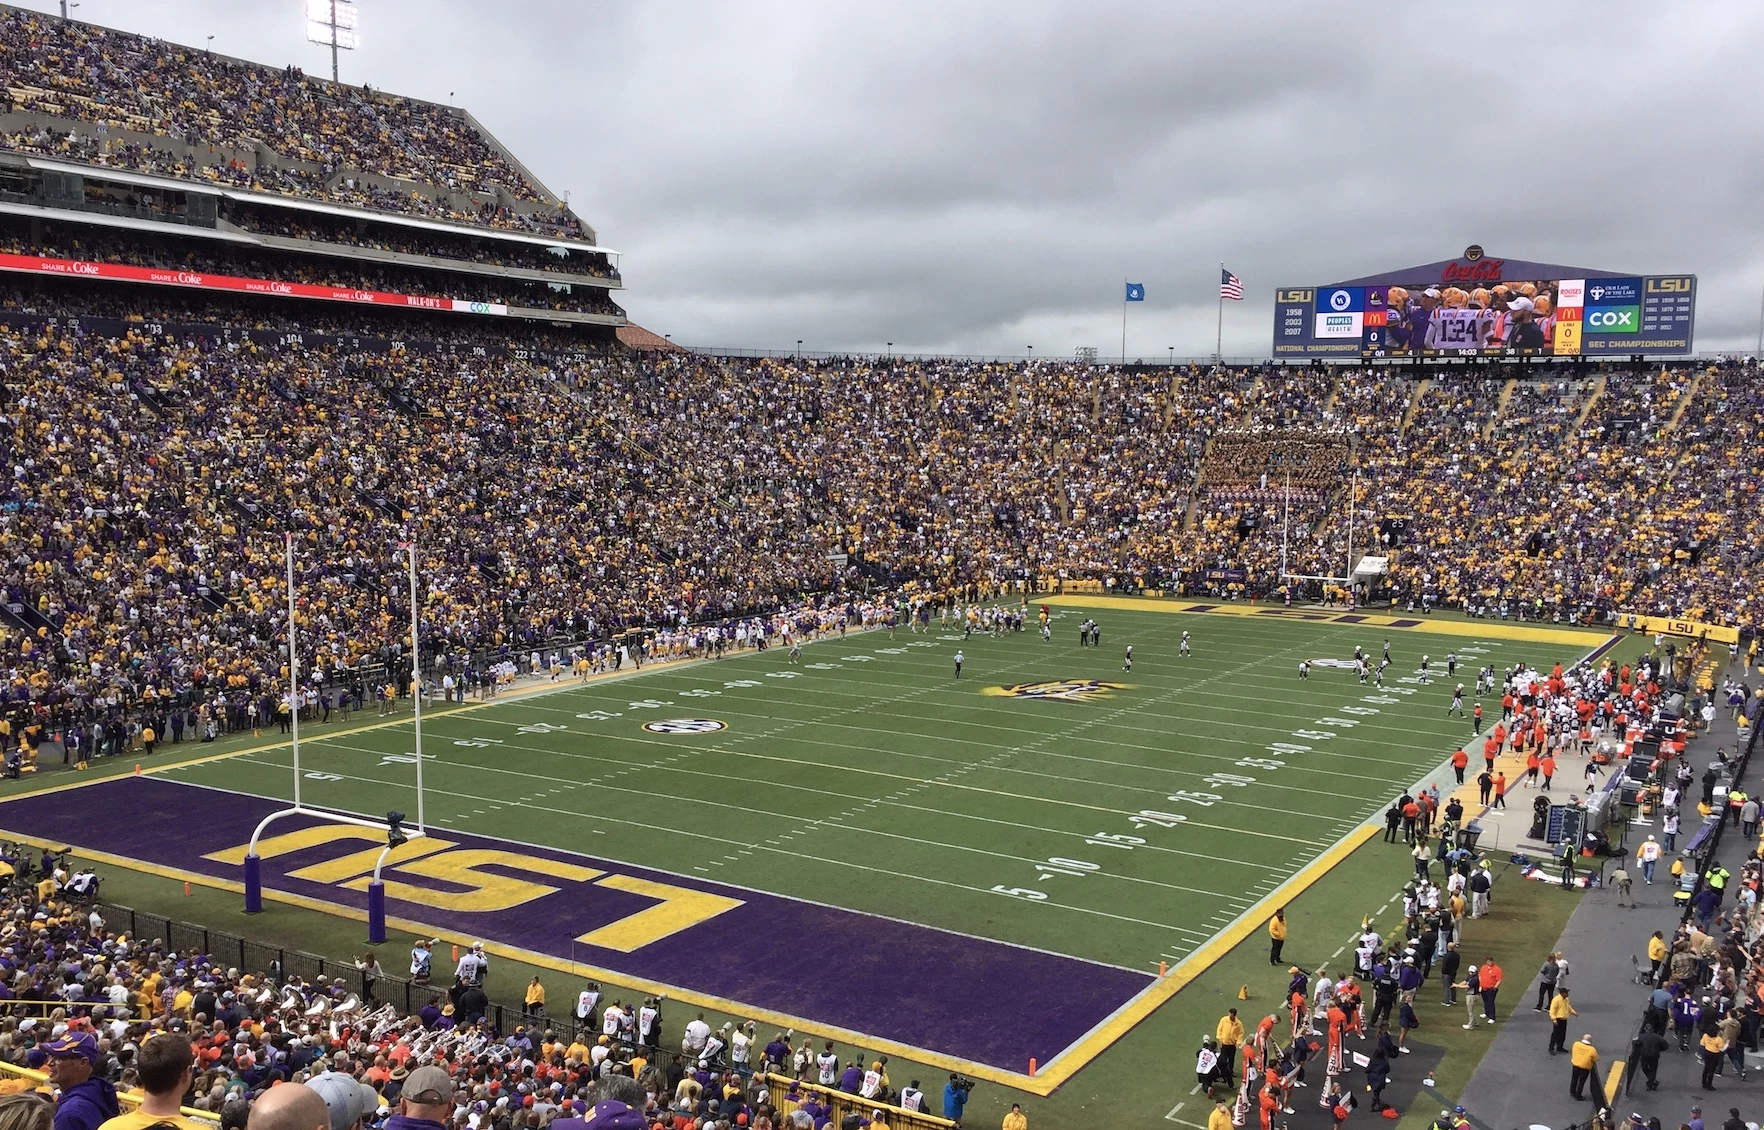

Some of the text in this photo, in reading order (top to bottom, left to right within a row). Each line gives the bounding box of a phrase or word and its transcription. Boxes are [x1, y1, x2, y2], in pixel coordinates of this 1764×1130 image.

[42, 263, 65, 271] SHARE
[73, 262, 99, 274] Coke
[1443, 259, 1504, 282] Coca-Cola
[178, 272, 202, 284] Coke
[246, 283, 265, 291] SHARE
[270, 282, 292, 293] Coke
[1648, 279, 1690, 293] LSU
[355, 290, 374, 301] Coke
[1278, 290, 1312, 303] LSU
[470, 302, 490, 312] COX
[1589, 312, 1632, 326] COX
[1285, 328, 1301, 336] 2007
[1370, 332, 1378, 341] 0
[1564, 329, 1572, 337] 0
[286, 334, 303, 343] 104
[1609, 340, 1685, 348] CHAMPIONSHIPS
[391, 342, 405, 350] 105
[473, 347, 486, 356] 106
[515, 350, 528, 359] 222
[1392, 519, 1403, 528] 25
[1668, 622, 1694, 633] LSU
[517, 722, 568, 734] 20
[453, 737, 503, 748] 15
[381, 752, 437, 764] 10
[304, 772, 344, 782] 5
[1167, 790, 1223, 806] 25
[1128, 809, 1188, 828] 20
[1085, 832, 1146, 850] 15
[1035, 857, 1101, 877] 10
[201, 824, 746, 953] LSU
[991, 885, 1048, 900] 5
[1684, 1002, 1688, 1014] 1
